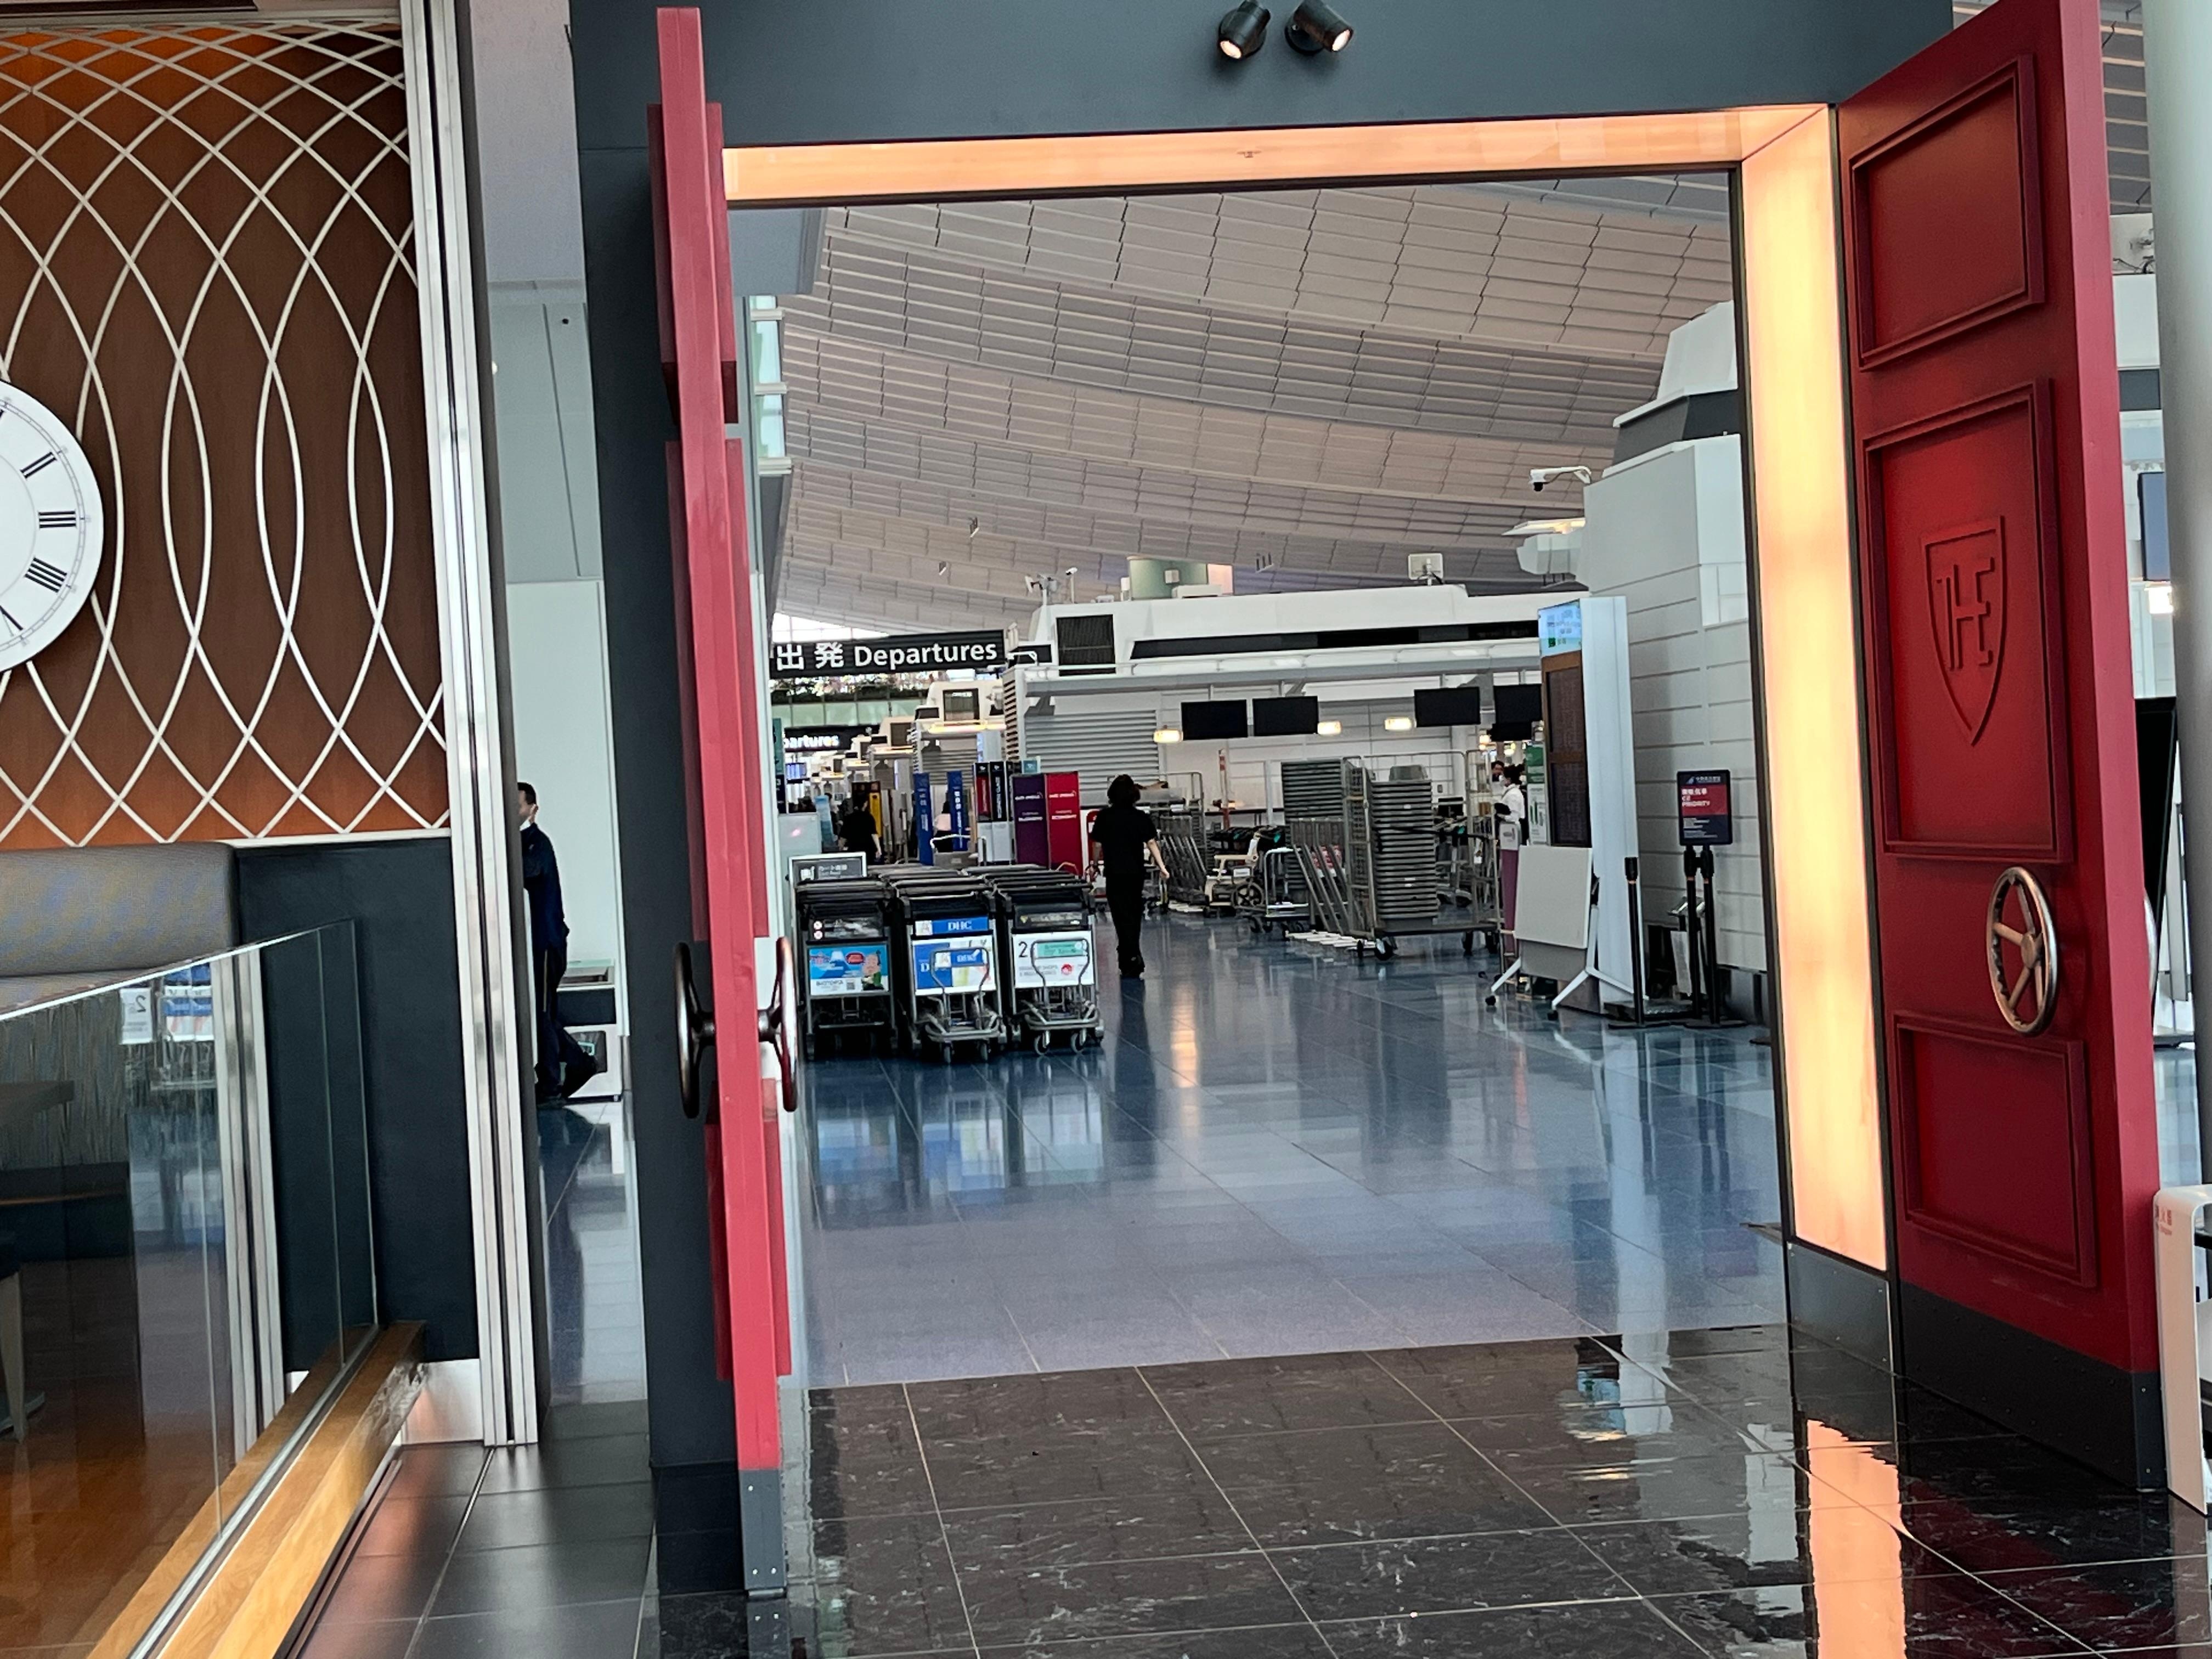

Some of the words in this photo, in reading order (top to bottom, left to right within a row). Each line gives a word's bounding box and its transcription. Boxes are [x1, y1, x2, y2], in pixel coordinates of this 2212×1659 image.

[776, 642, 844, 671] 出発
[854, 642, 997, 670] Departures
[948, 921, 972, 931] DHC
